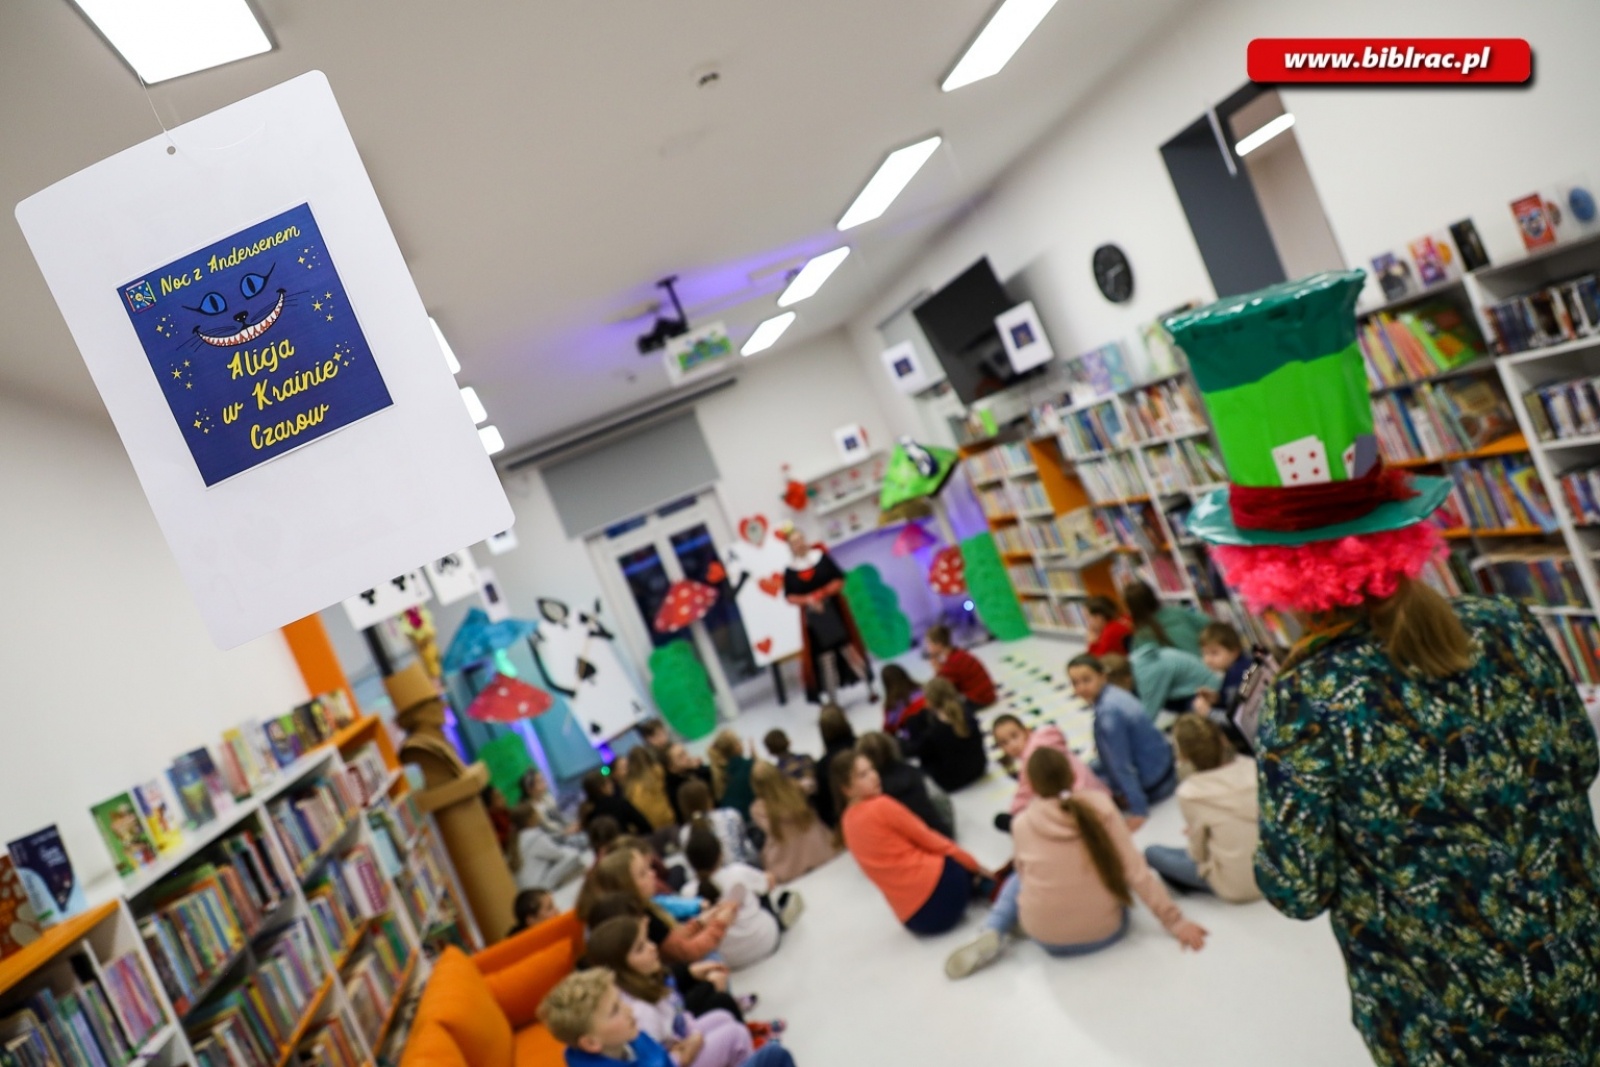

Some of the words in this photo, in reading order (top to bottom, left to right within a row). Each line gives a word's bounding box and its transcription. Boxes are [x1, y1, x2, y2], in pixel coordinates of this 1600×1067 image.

[160, 276, 191, 297] Noc
[193, 269, 202, 281] z
[207, 224, 300, 273] Andersenem
[227, 338, 295, 379] Alicja
[222, 402, 243, 424] w
[252, 358, 339, 410] Krainie
[250, 403, 329, 449] Czarow
